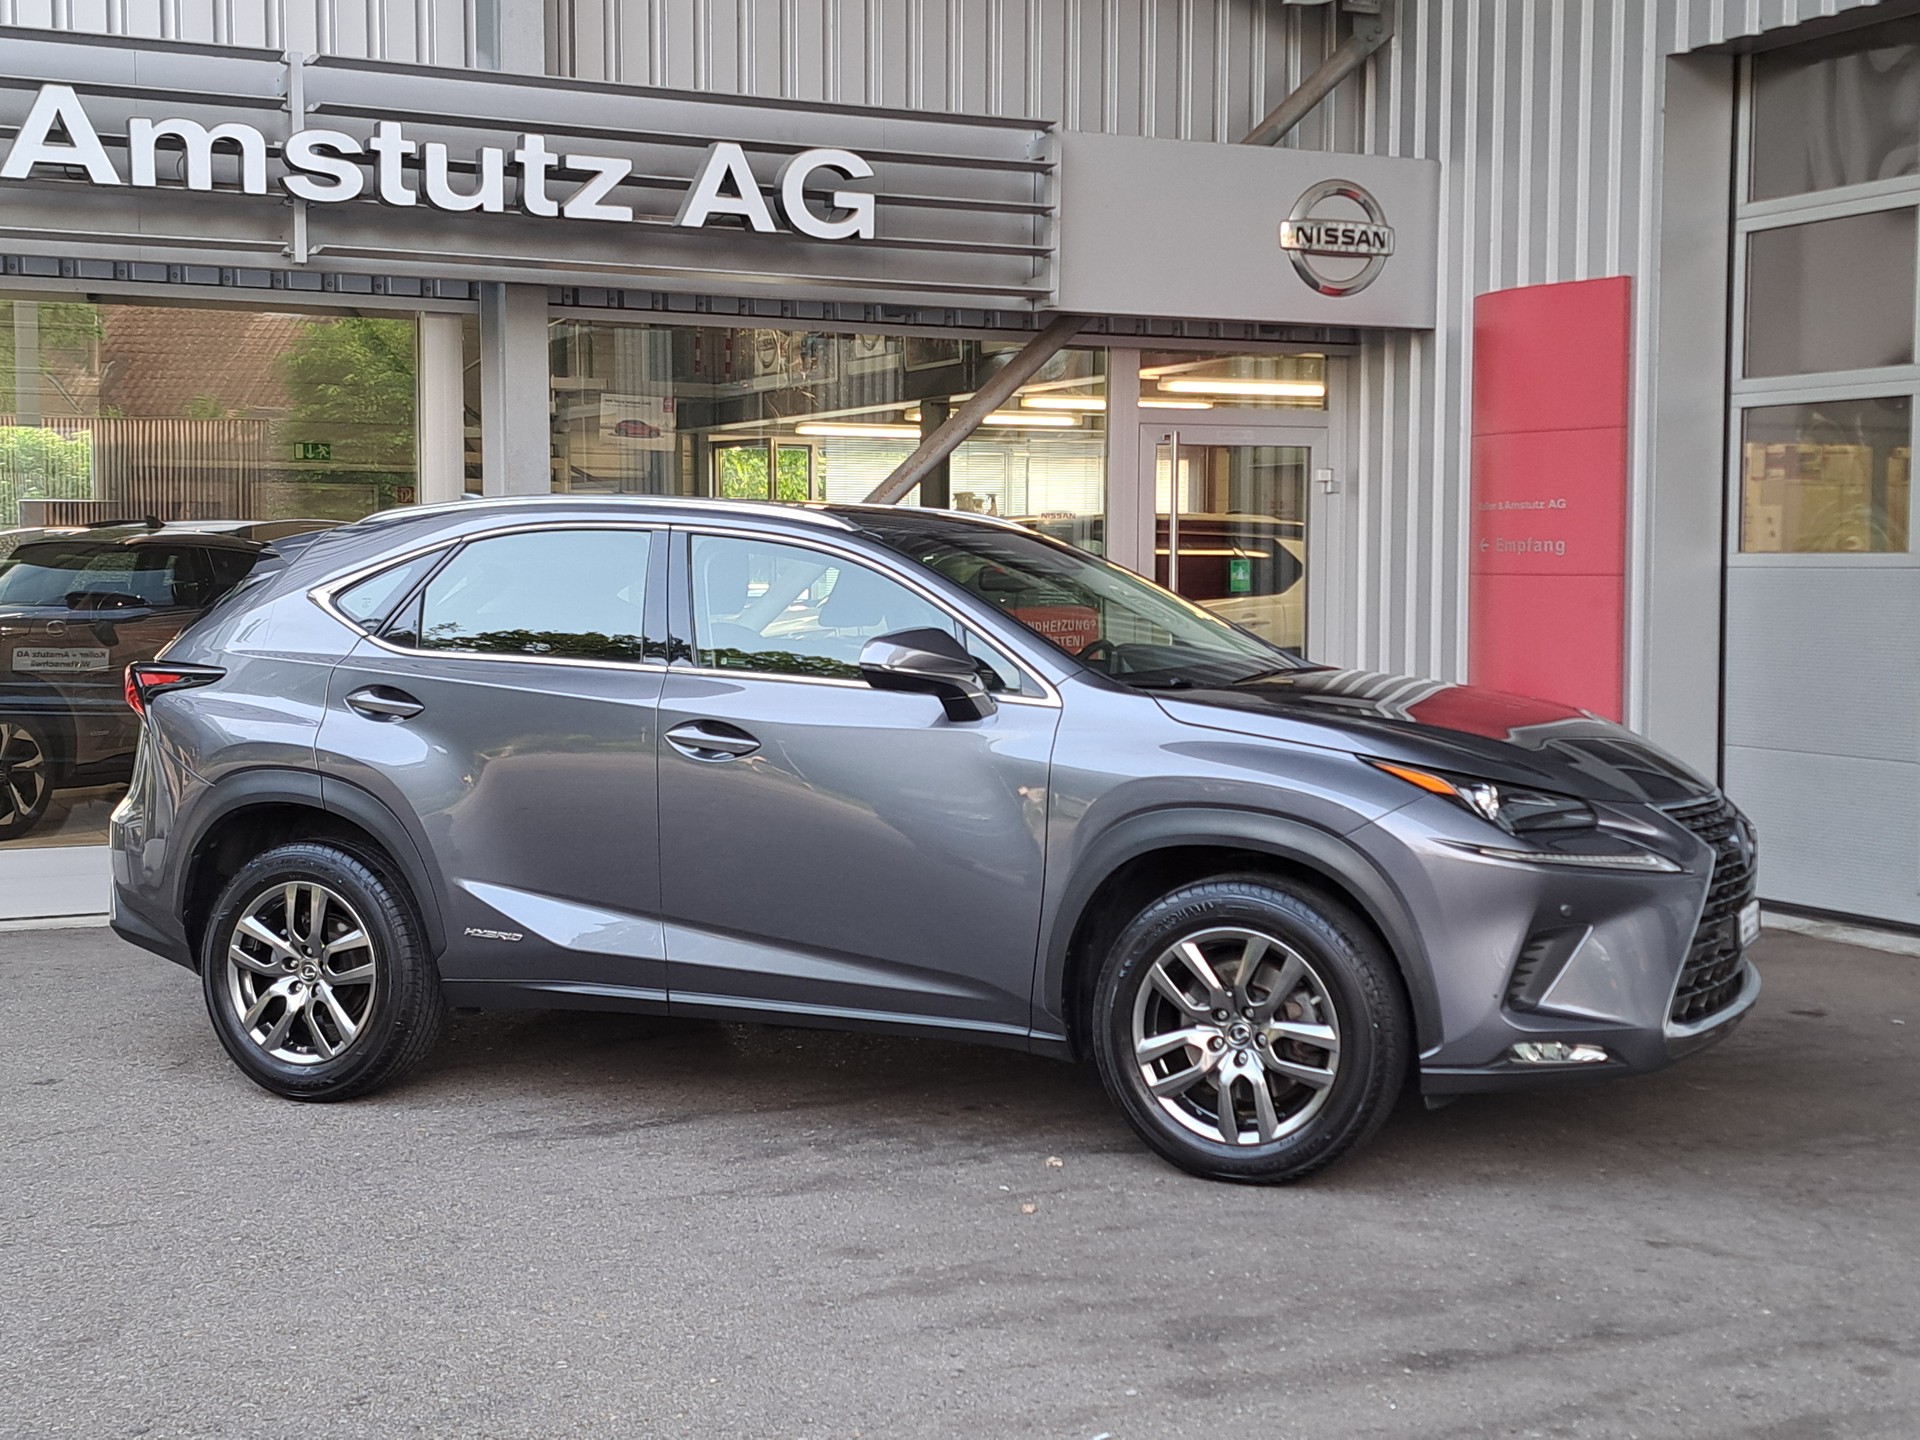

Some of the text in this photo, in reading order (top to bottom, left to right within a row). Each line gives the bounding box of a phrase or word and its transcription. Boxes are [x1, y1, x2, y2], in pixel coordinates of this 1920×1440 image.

[0, 84, 876, 240] Amstutz AG
[1295, 226, 1386, 248] NISSAN
[1548, 498, 1567, 509] AG
[1496, 537, 1566, 556] Empfang
[1023, 619, 1097, 632] NDHEIZUNG?
[463, 927, 524, 941] HYBRID
